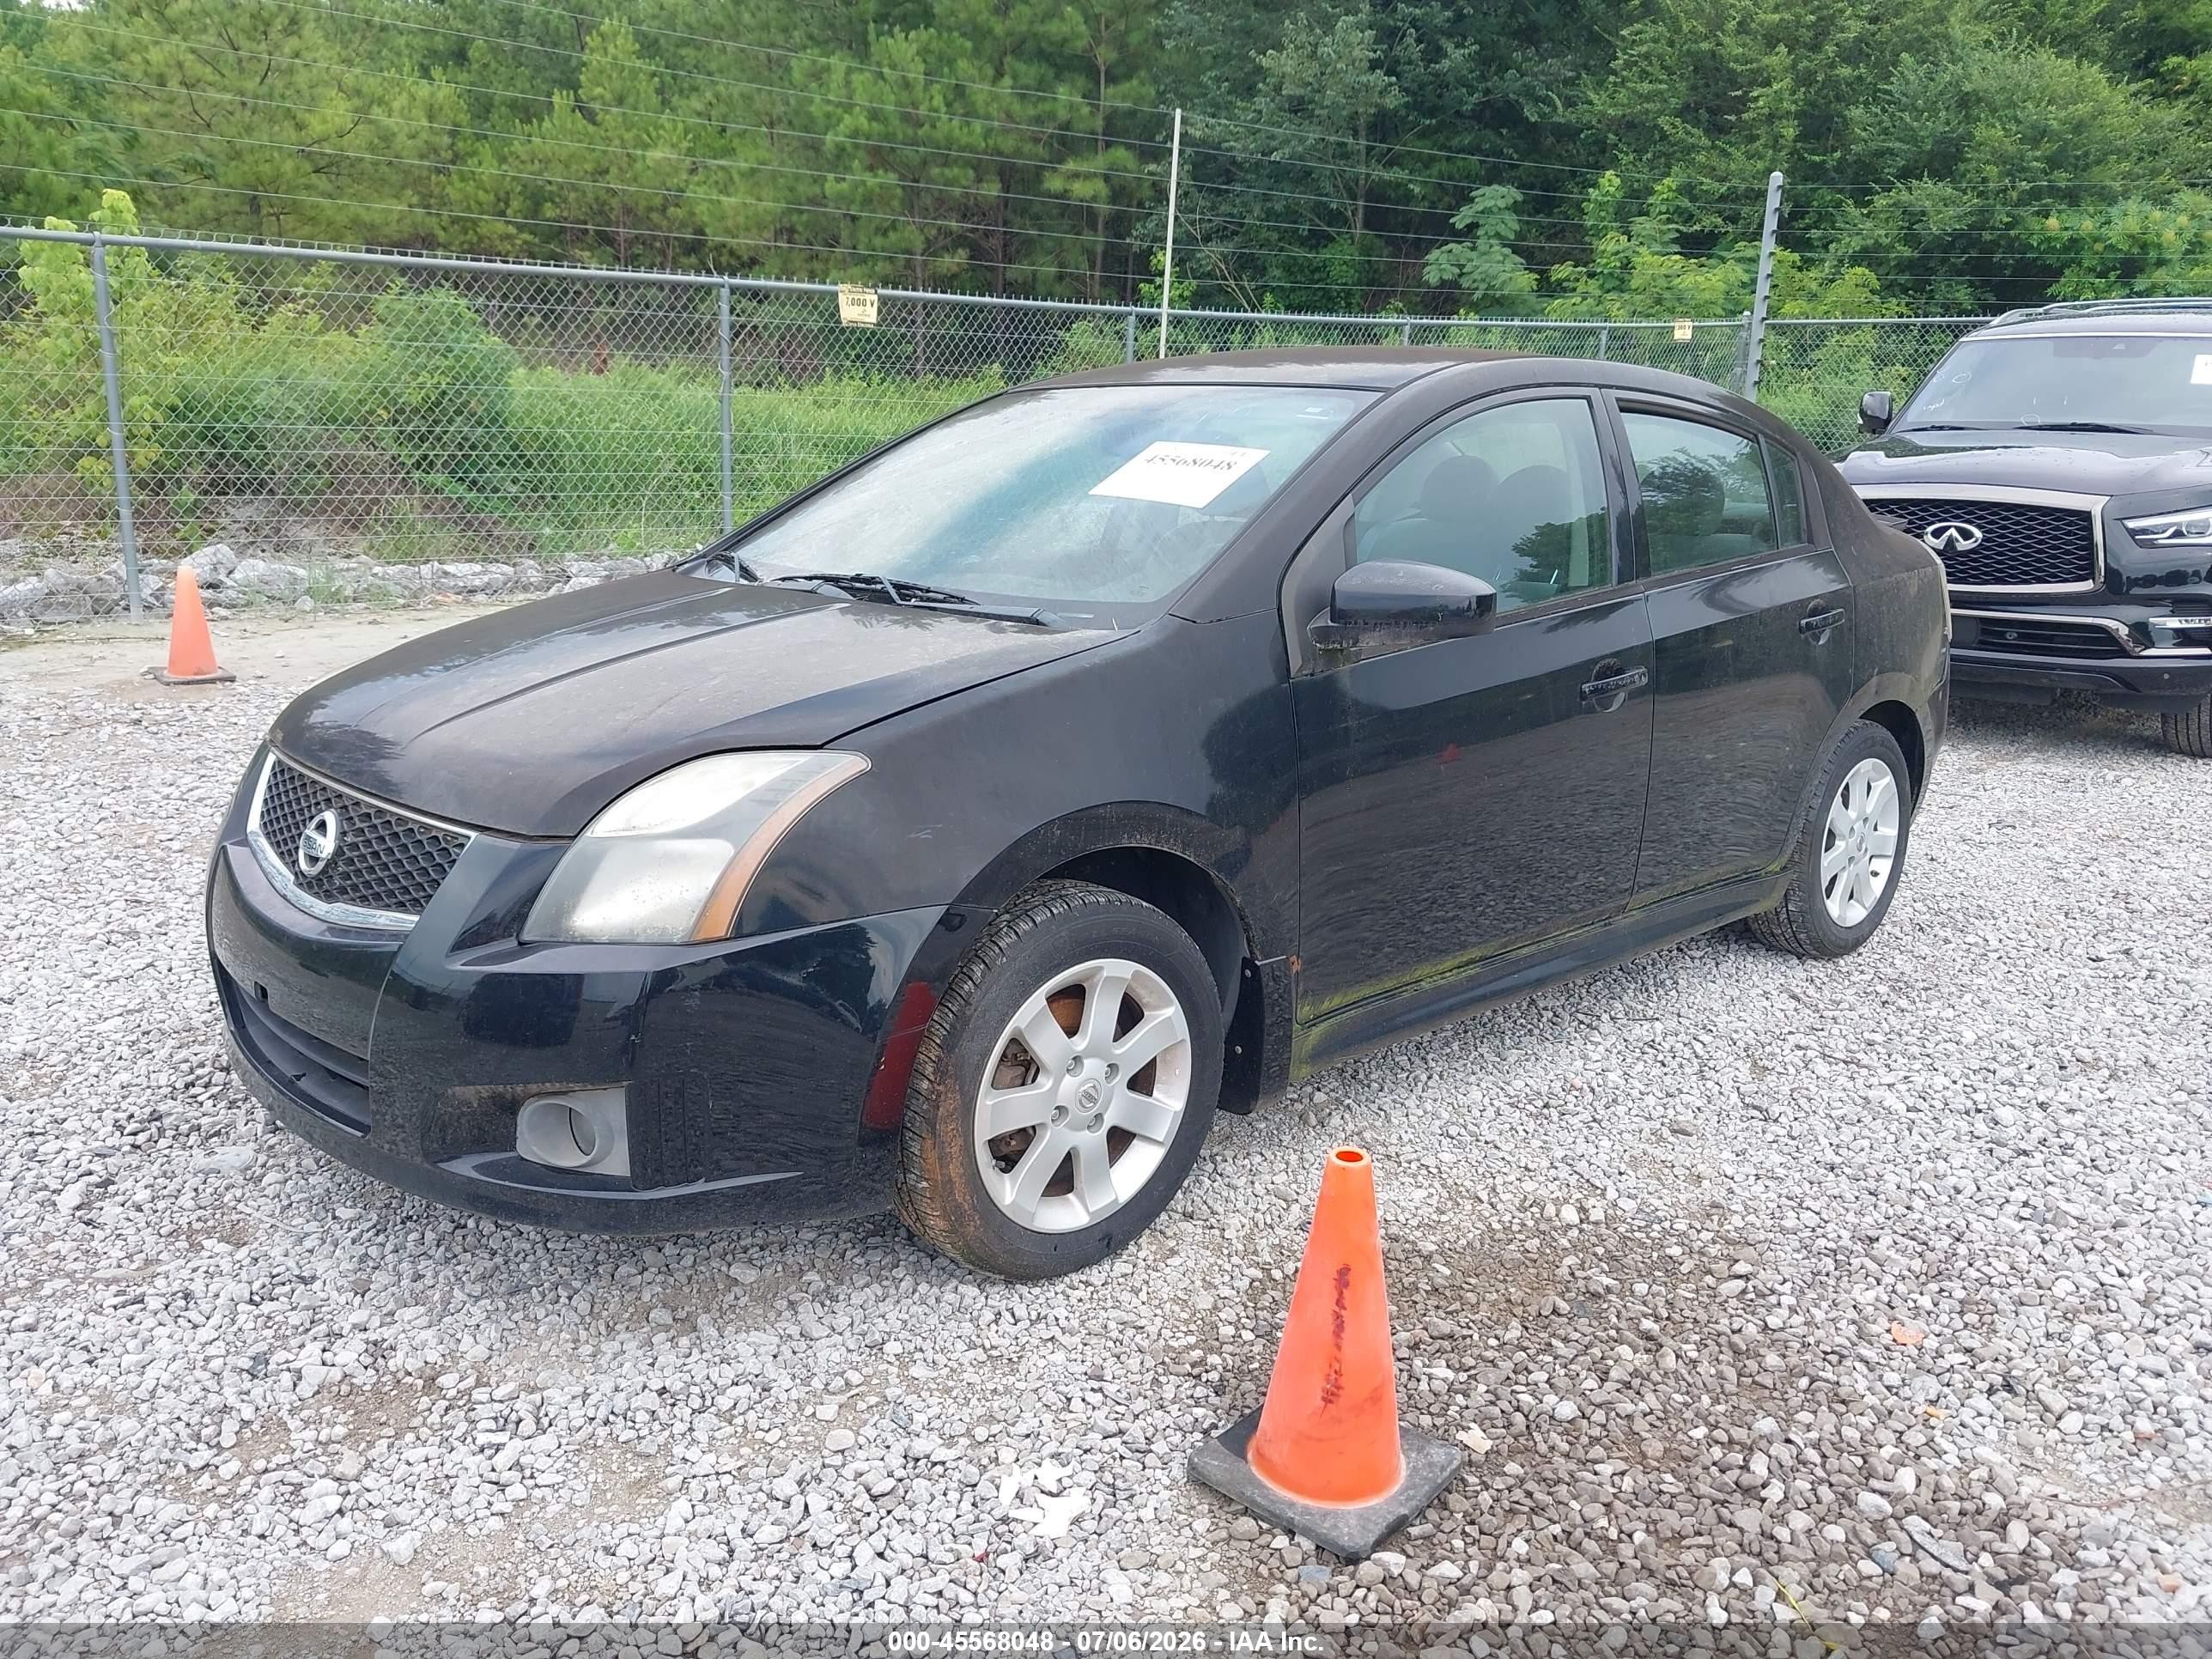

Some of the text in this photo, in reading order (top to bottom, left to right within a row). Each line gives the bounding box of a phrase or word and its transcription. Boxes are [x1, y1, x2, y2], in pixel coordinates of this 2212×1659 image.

[846, 296, 876, 308] 7,000 V
[1144, 453, 1237, 471] 45568048
